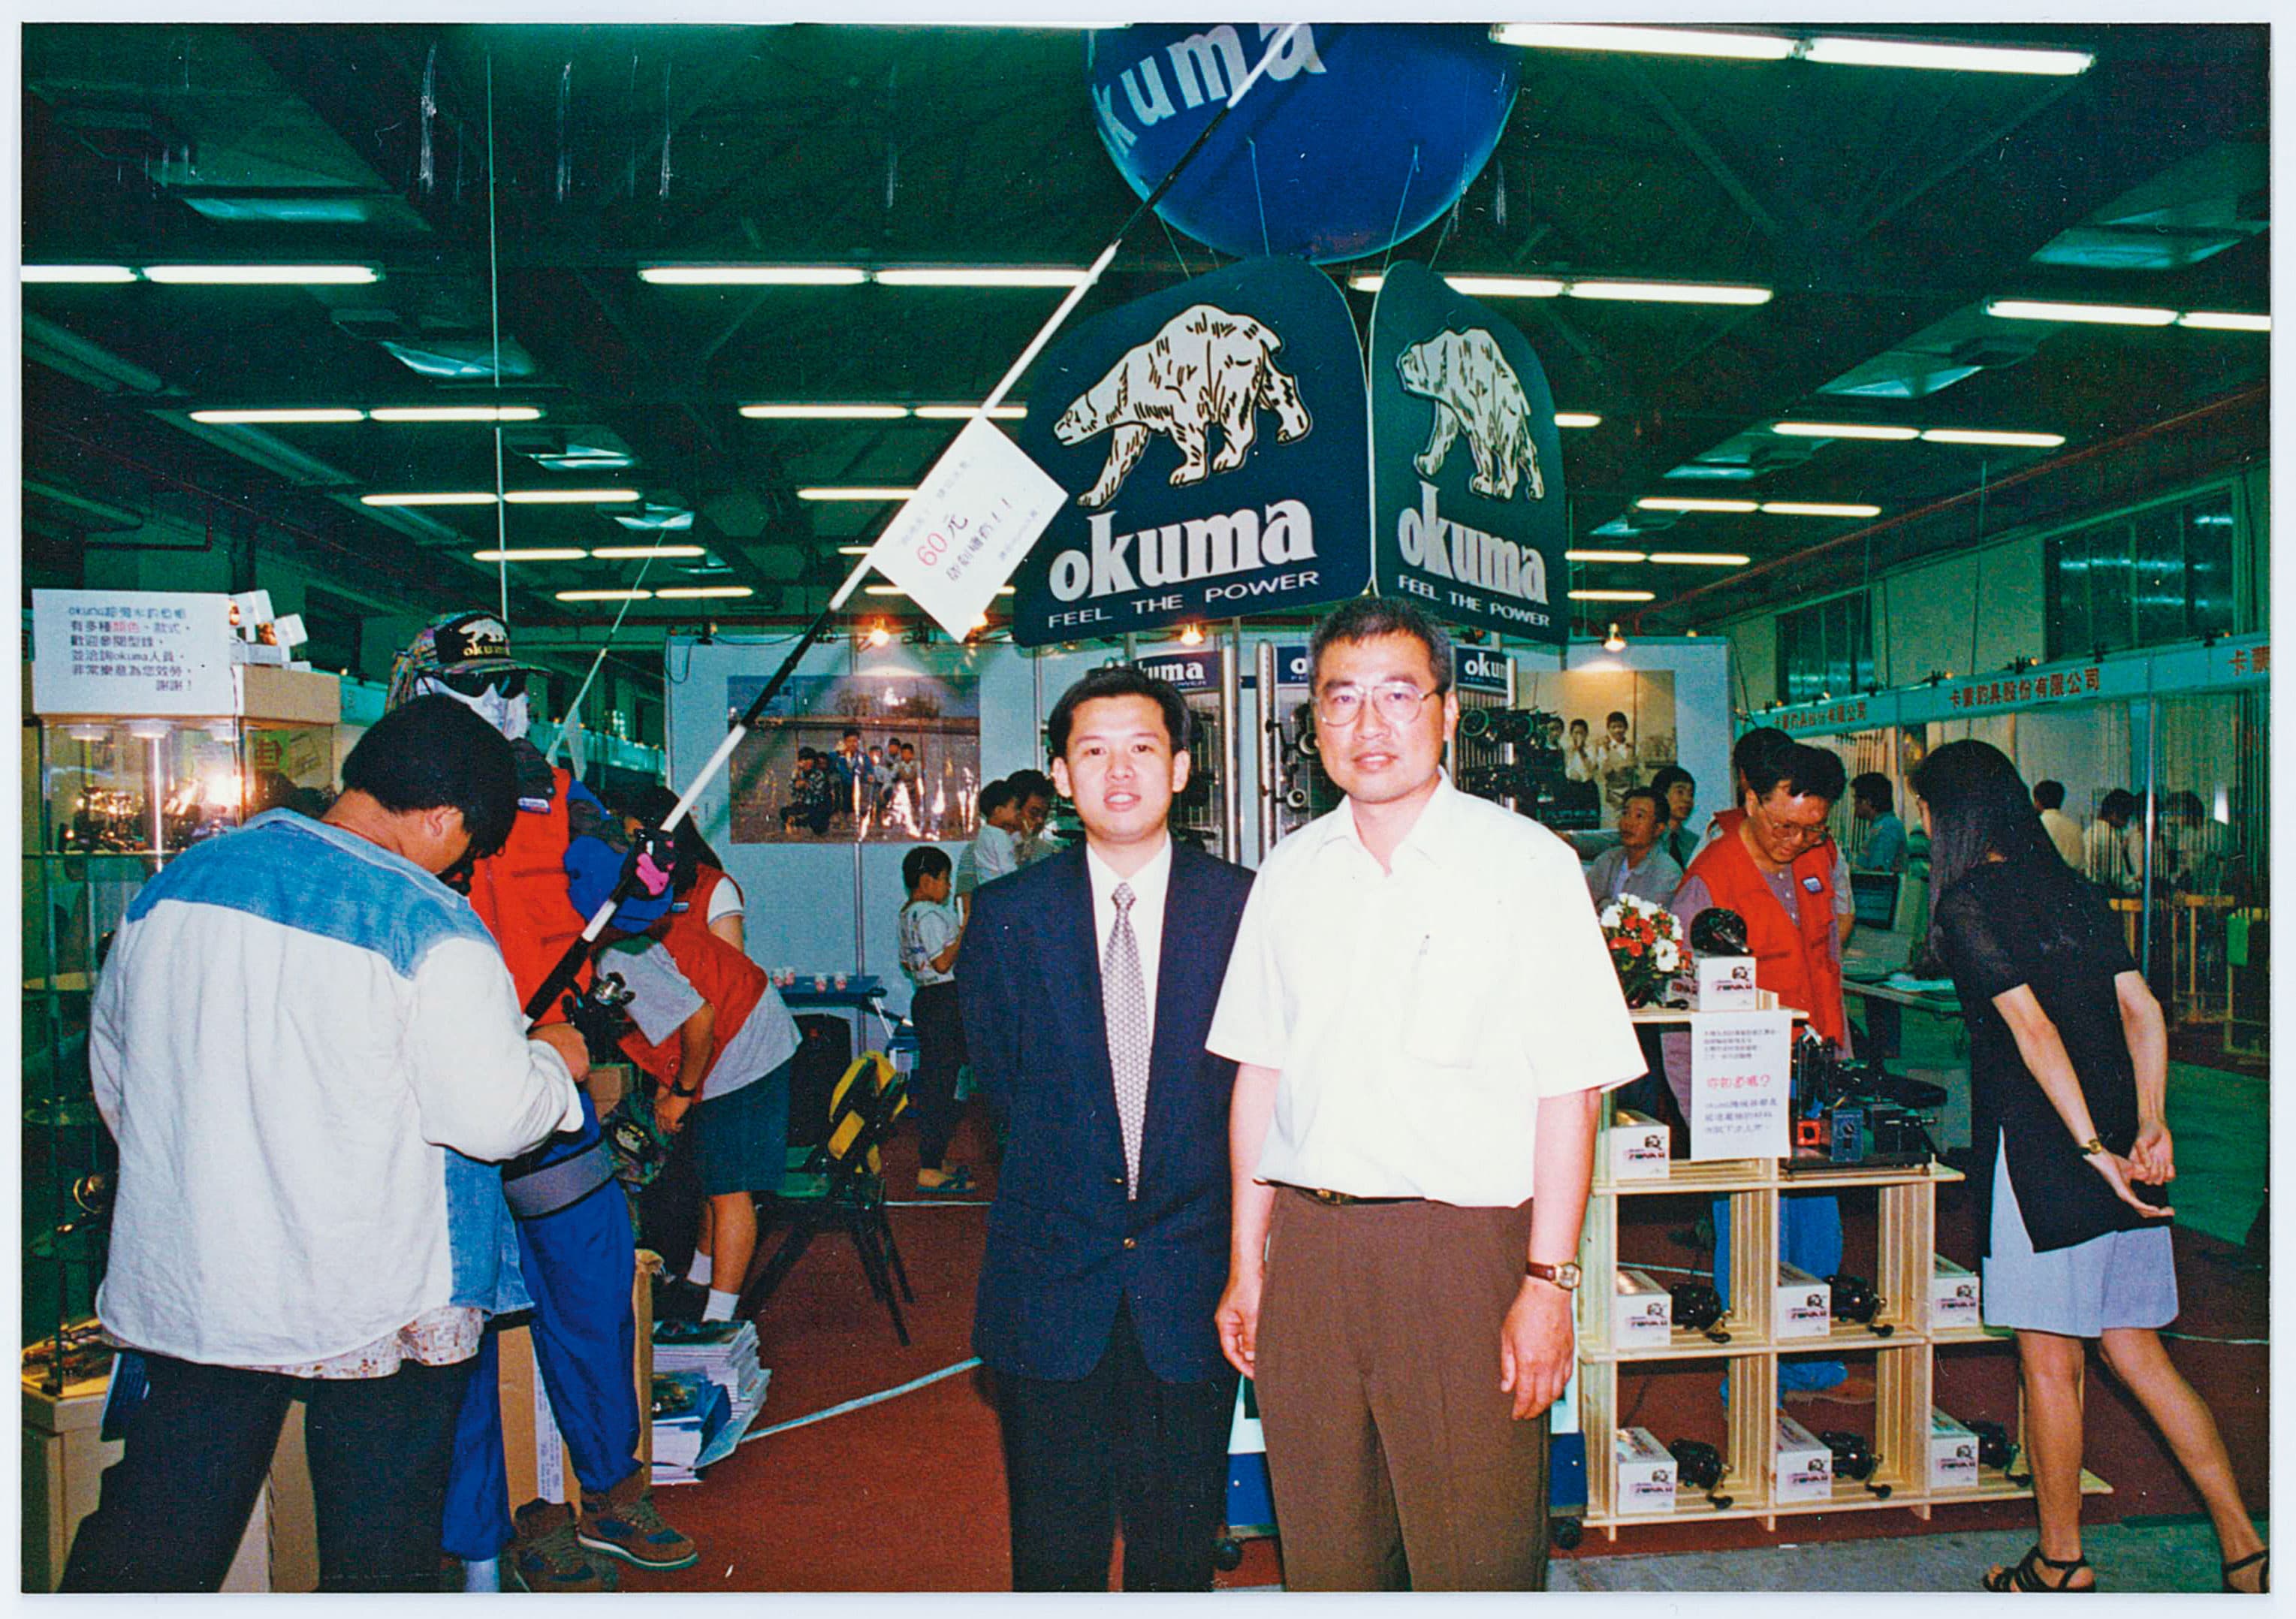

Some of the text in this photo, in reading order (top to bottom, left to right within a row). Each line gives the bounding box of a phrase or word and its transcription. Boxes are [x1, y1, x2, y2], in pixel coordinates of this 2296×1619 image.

[916, 514, 969, 567] 60元
[1049, 499, 1317, 602] okuma
[1399, 481, 1549, 605] okuma
[1048, 571, 1320, 629] FEEL THE POWER
[1398, 574, 1550, 627] FEEL THE POWER
[1139, 661, 1205, 682] uma
